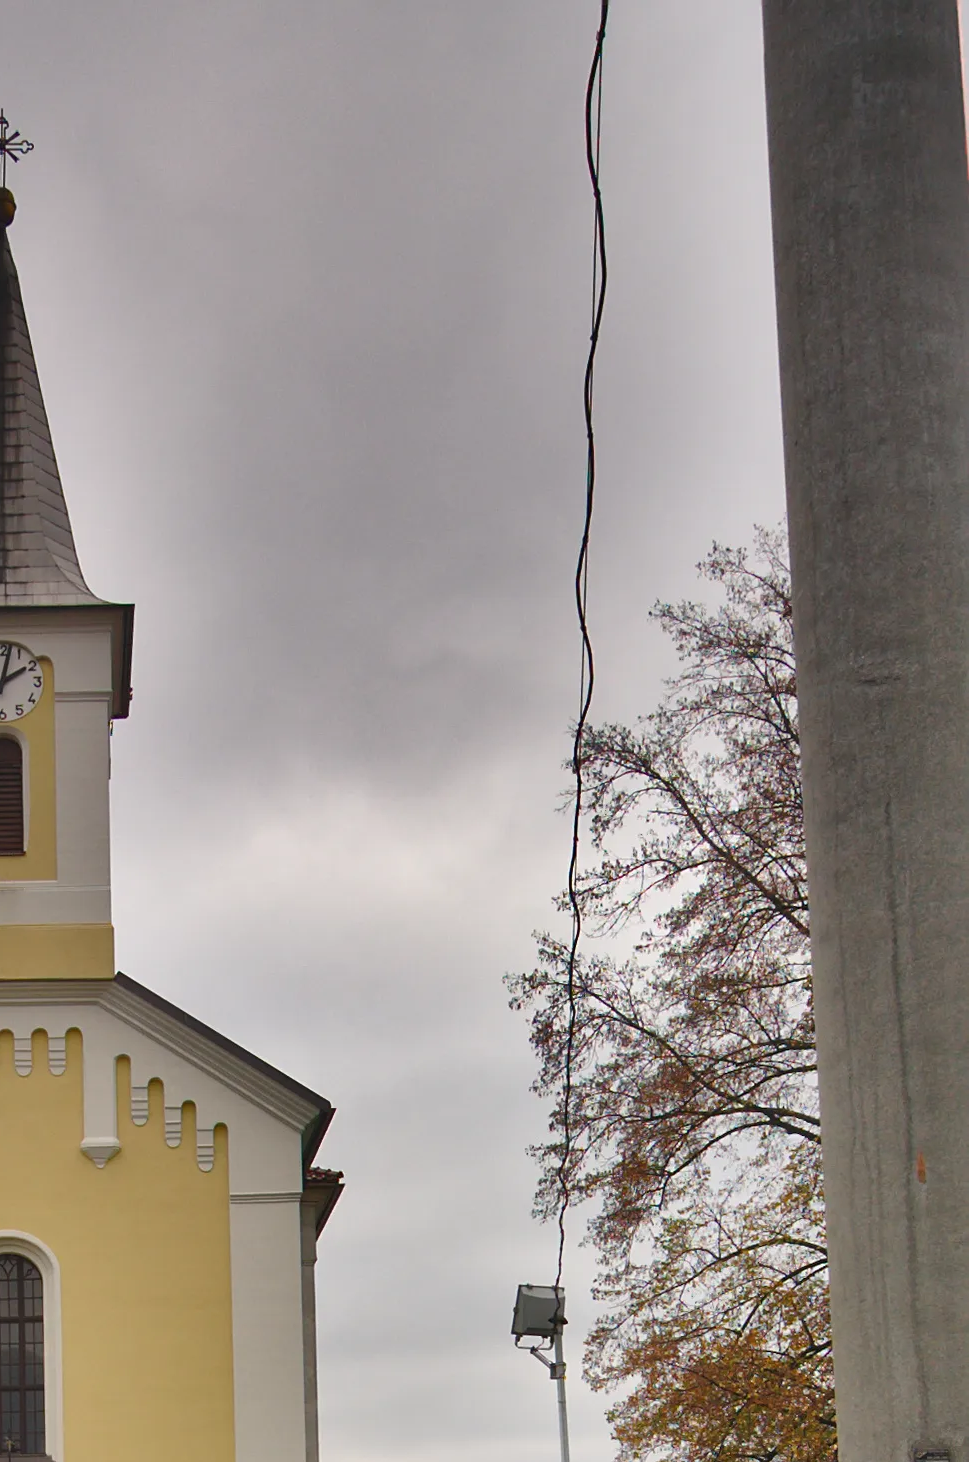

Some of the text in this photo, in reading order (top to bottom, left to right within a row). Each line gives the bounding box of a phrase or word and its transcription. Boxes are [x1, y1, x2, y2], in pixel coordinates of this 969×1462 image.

[18, 649, 20, 659] 1
[28, 660, 37, 671] 2
[33, 676, 41, 687] 3
[28, 693, 35, 704] 4
[0, 709, 6, 720] 6
[16, 705, 23, 715] 5
